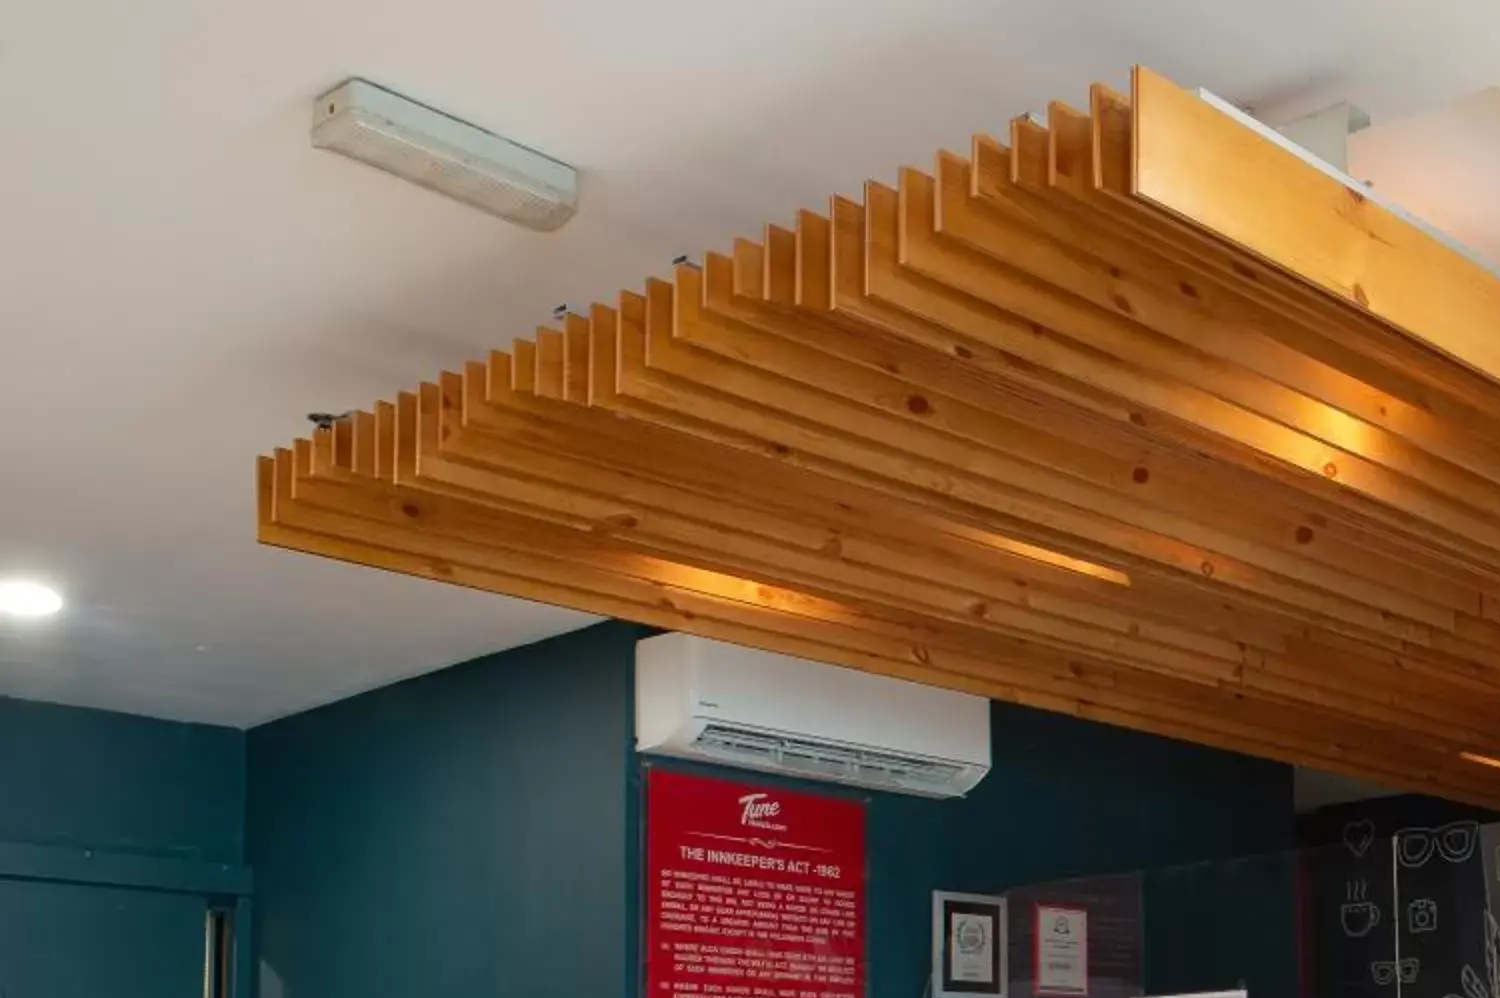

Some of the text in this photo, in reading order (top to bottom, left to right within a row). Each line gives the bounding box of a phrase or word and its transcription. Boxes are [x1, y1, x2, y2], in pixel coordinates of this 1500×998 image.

[738, 793, 780, 825] Tune
[680, 845, 705, 861] THE
[707, 849, 784, 871] INNKEEPER'S
[787, 860, 810, 874] ACT
